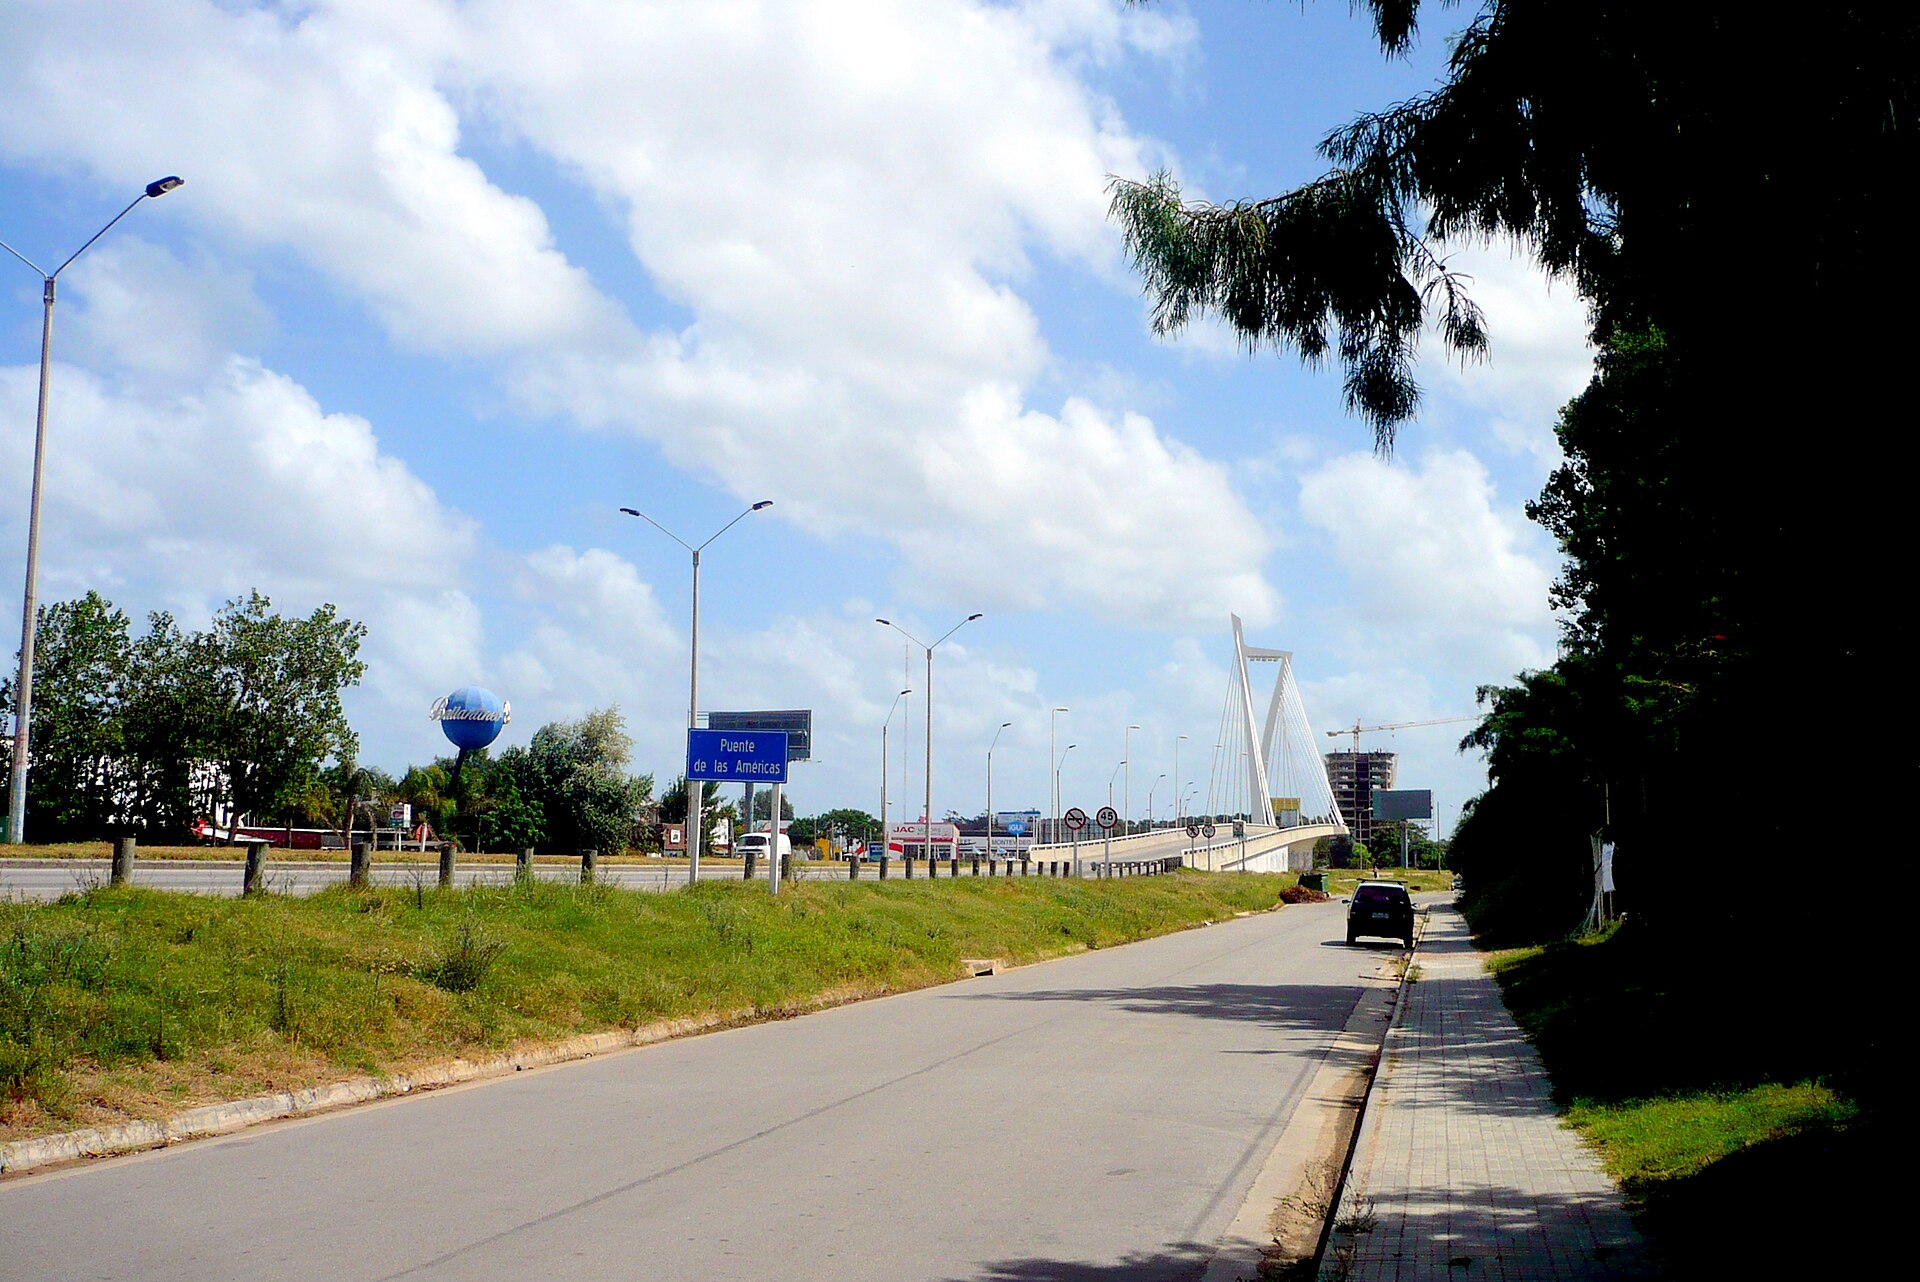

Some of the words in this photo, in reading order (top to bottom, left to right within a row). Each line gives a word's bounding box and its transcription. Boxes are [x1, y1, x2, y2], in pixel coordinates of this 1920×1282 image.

[720, 738, 755, 752] Puente
[693, 758, 707, 772] de
[714, 759, 728, 773] las
[735, 759, 780, 775] Américas
[1101, 811, 1114, 821] 45
